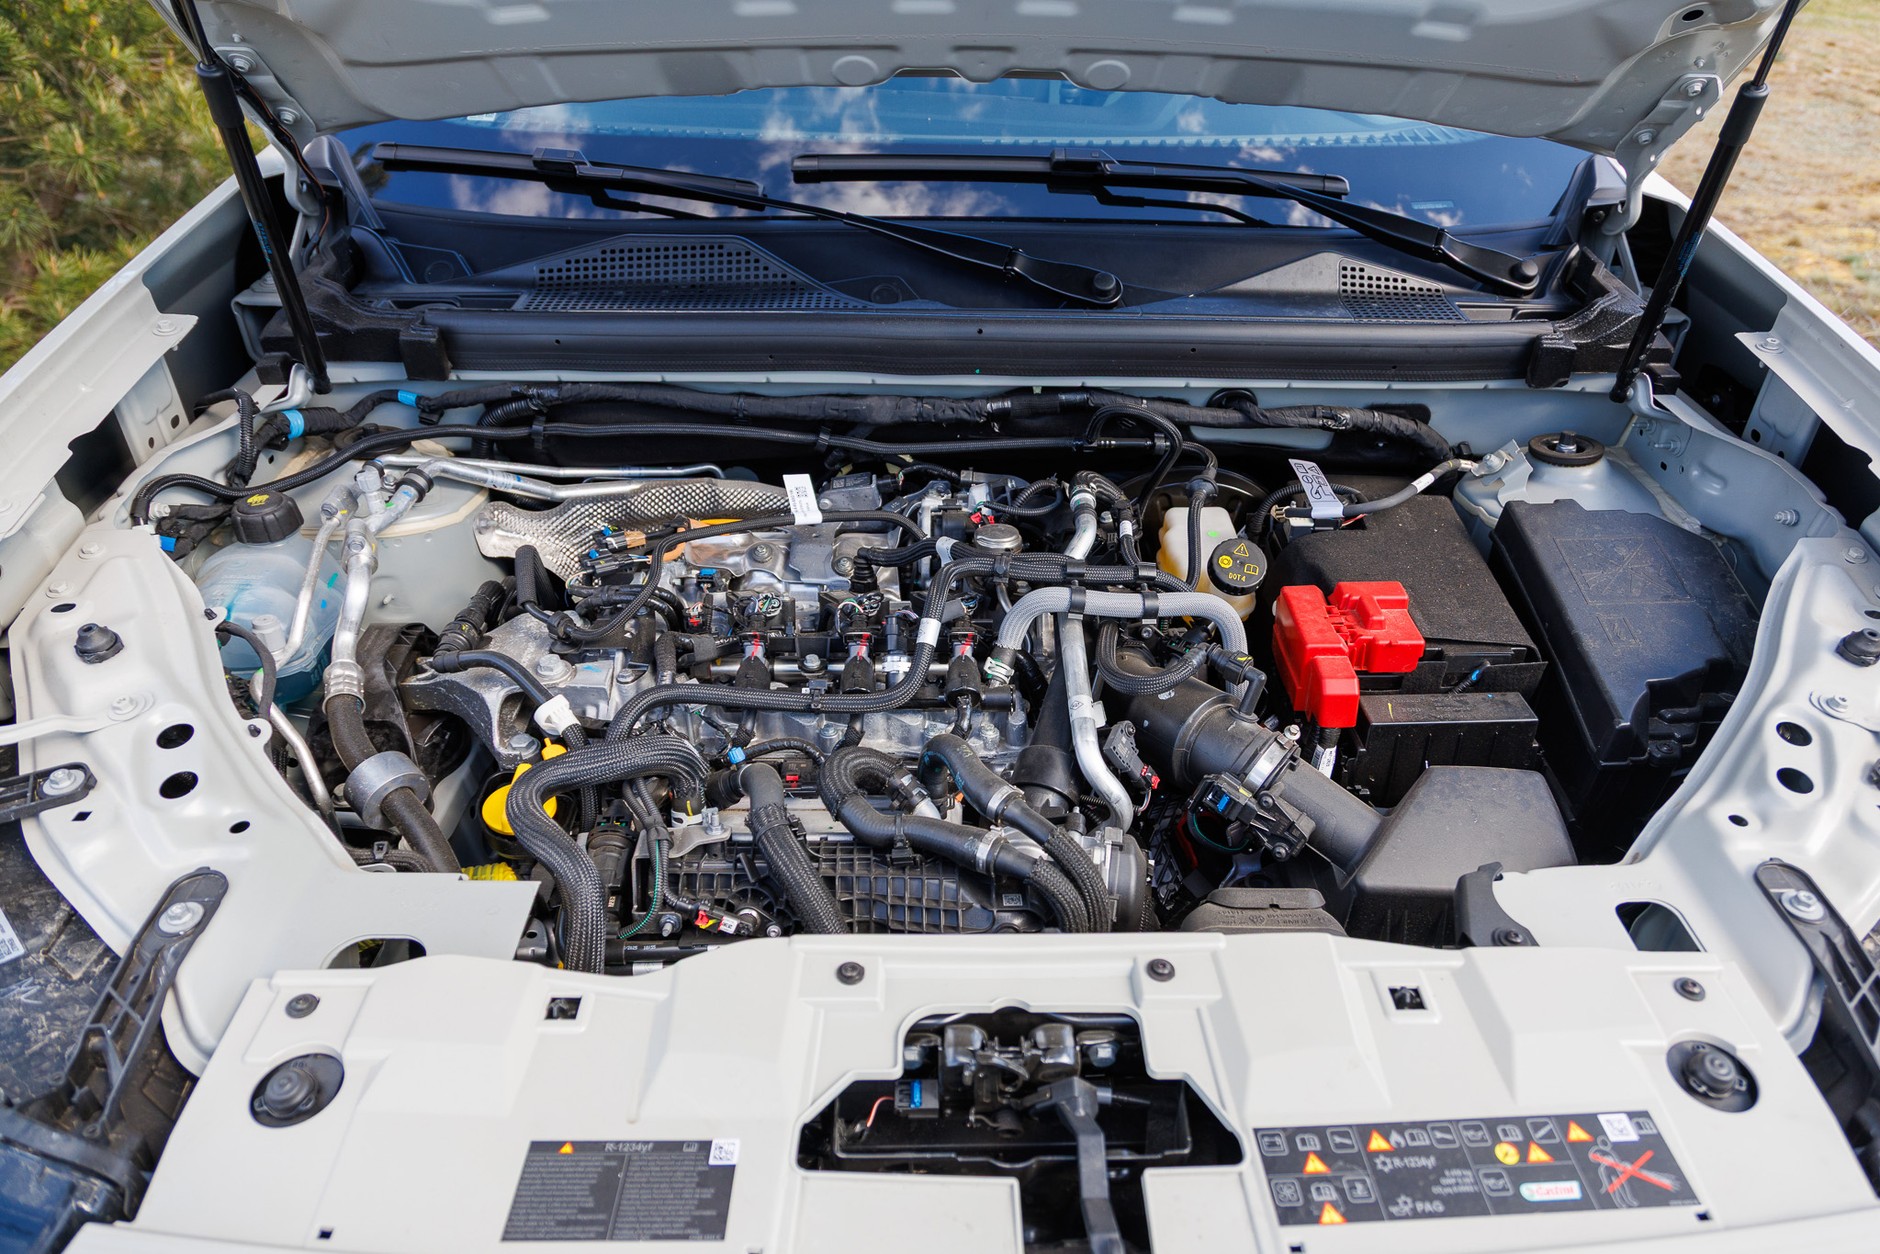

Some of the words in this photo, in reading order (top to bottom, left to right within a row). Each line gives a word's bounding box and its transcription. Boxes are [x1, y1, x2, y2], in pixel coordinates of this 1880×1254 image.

[1228, 572, 1241, 581] DOT
[604, 1142, 655, 1154] R-1234yf
[1391, 1155, 1436, 1169] R-1234yf
[1536, 1184, 1574, 1196] Castrol
[1415, 1200, 1445, 1214] PAG
